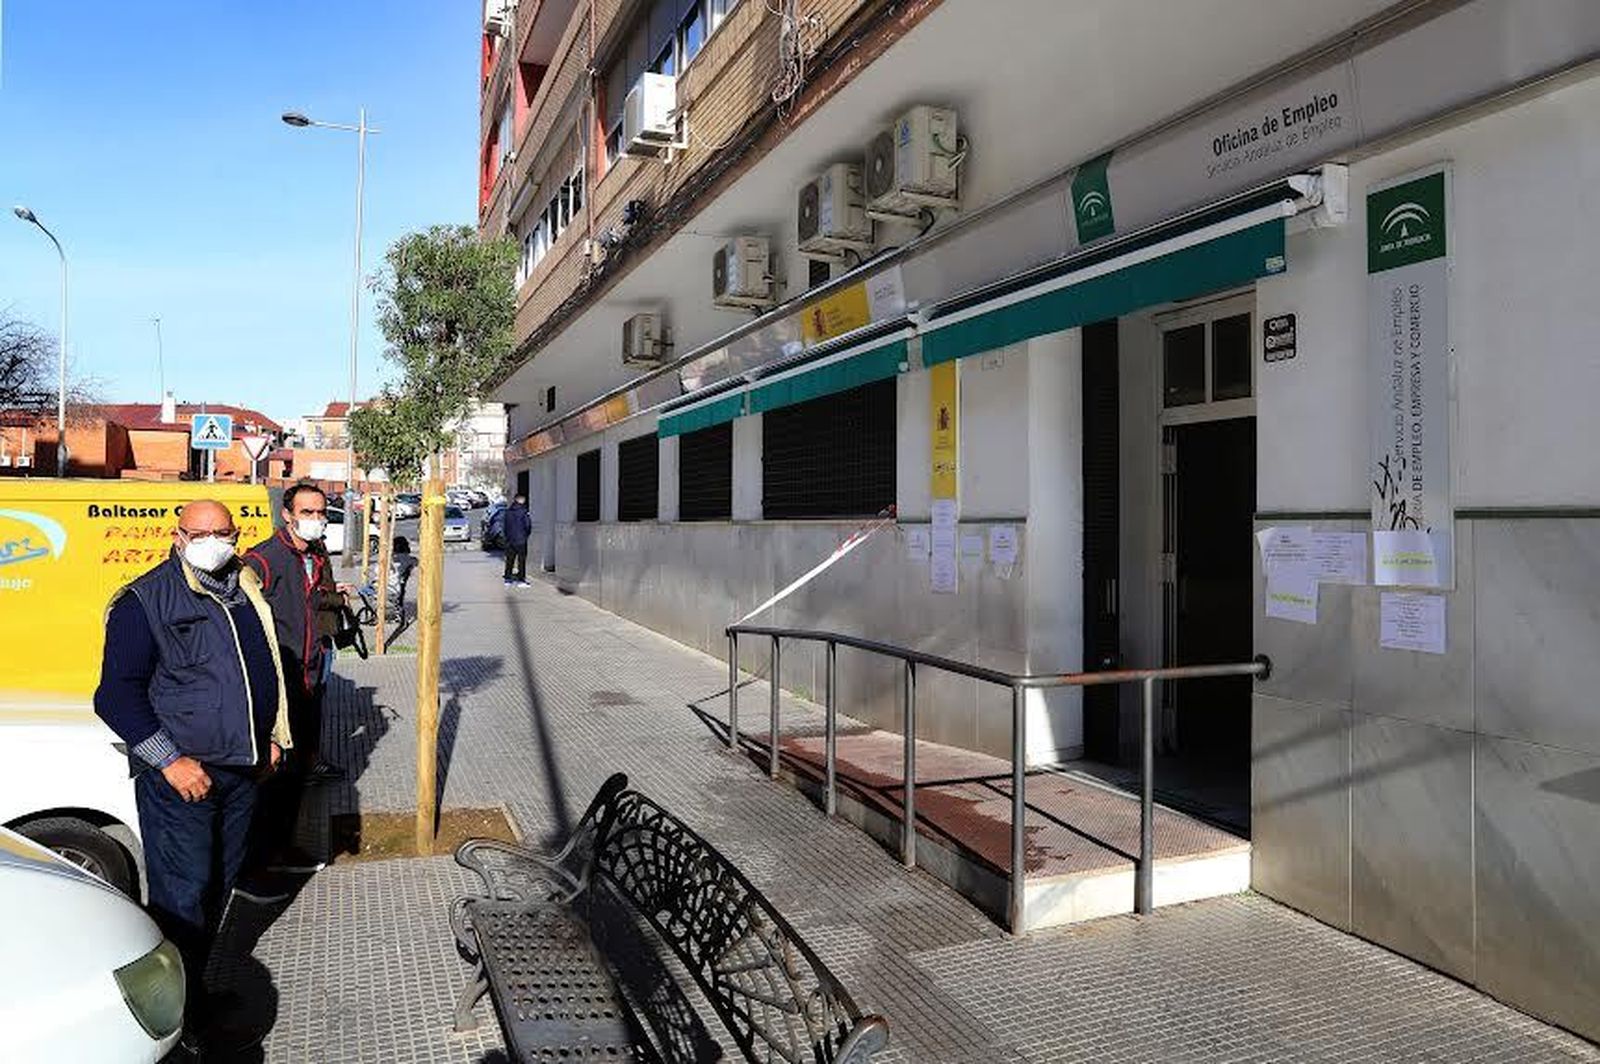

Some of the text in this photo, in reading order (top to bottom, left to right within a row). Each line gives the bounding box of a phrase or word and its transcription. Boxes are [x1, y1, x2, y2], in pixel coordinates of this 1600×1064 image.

[1212, 93, 1338, 157] Oficina de Empleo
[1408, 284, 1421, 349] COMERCIO
[1411, 474, 1423, 492] DE
[87, 504, 168, 518] Baltasar
[240, 505, 268, 518] S.L.
